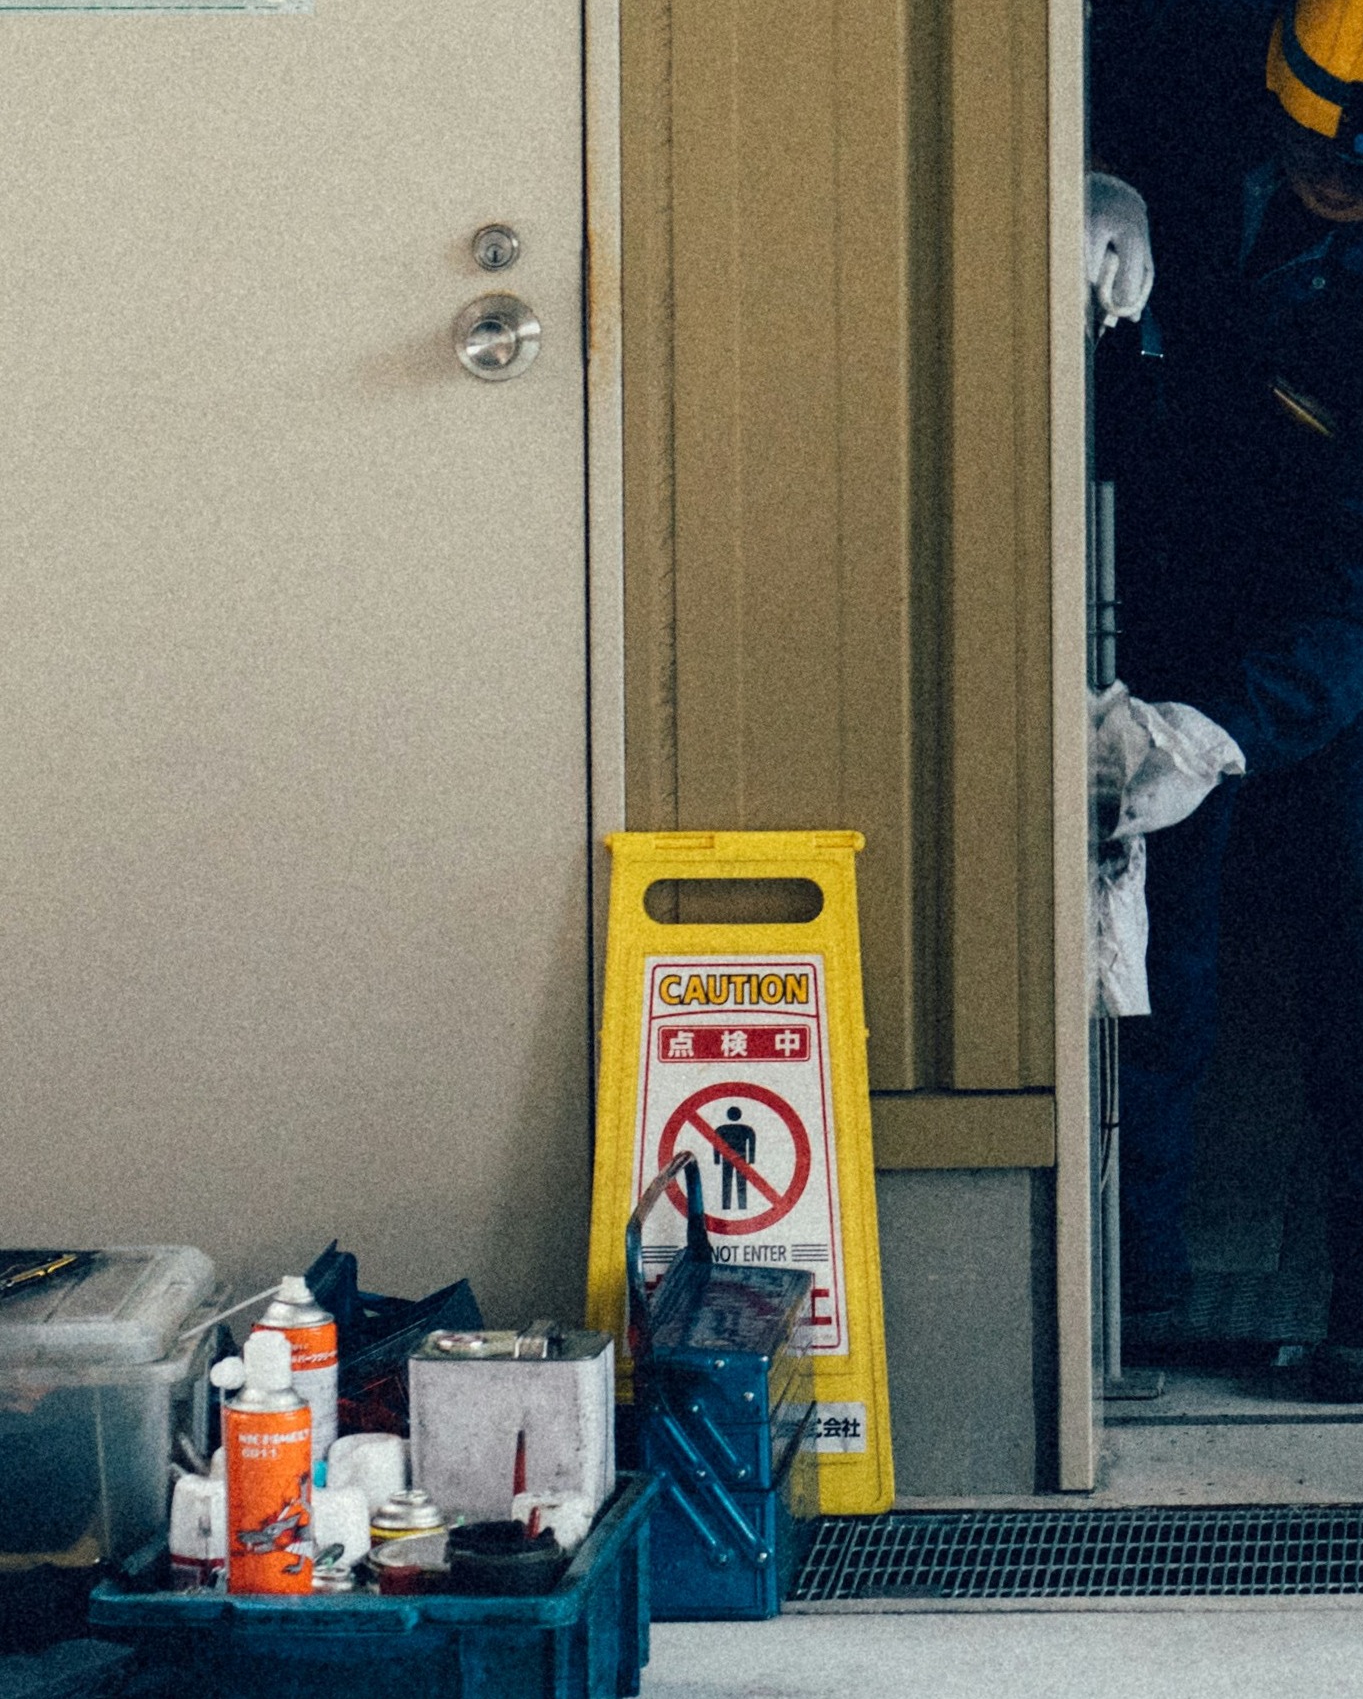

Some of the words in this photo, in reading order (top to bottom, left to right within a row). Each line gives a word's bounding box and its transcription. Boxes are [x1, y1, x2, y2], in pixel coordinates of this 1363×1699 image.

[659, 973, 810, 1006] CAUTION
[668, 1030, 801, 1057] 点検中
[711, 1245, 739, 1263] NOT
[743, 1245, 787, 1263] ENTER
